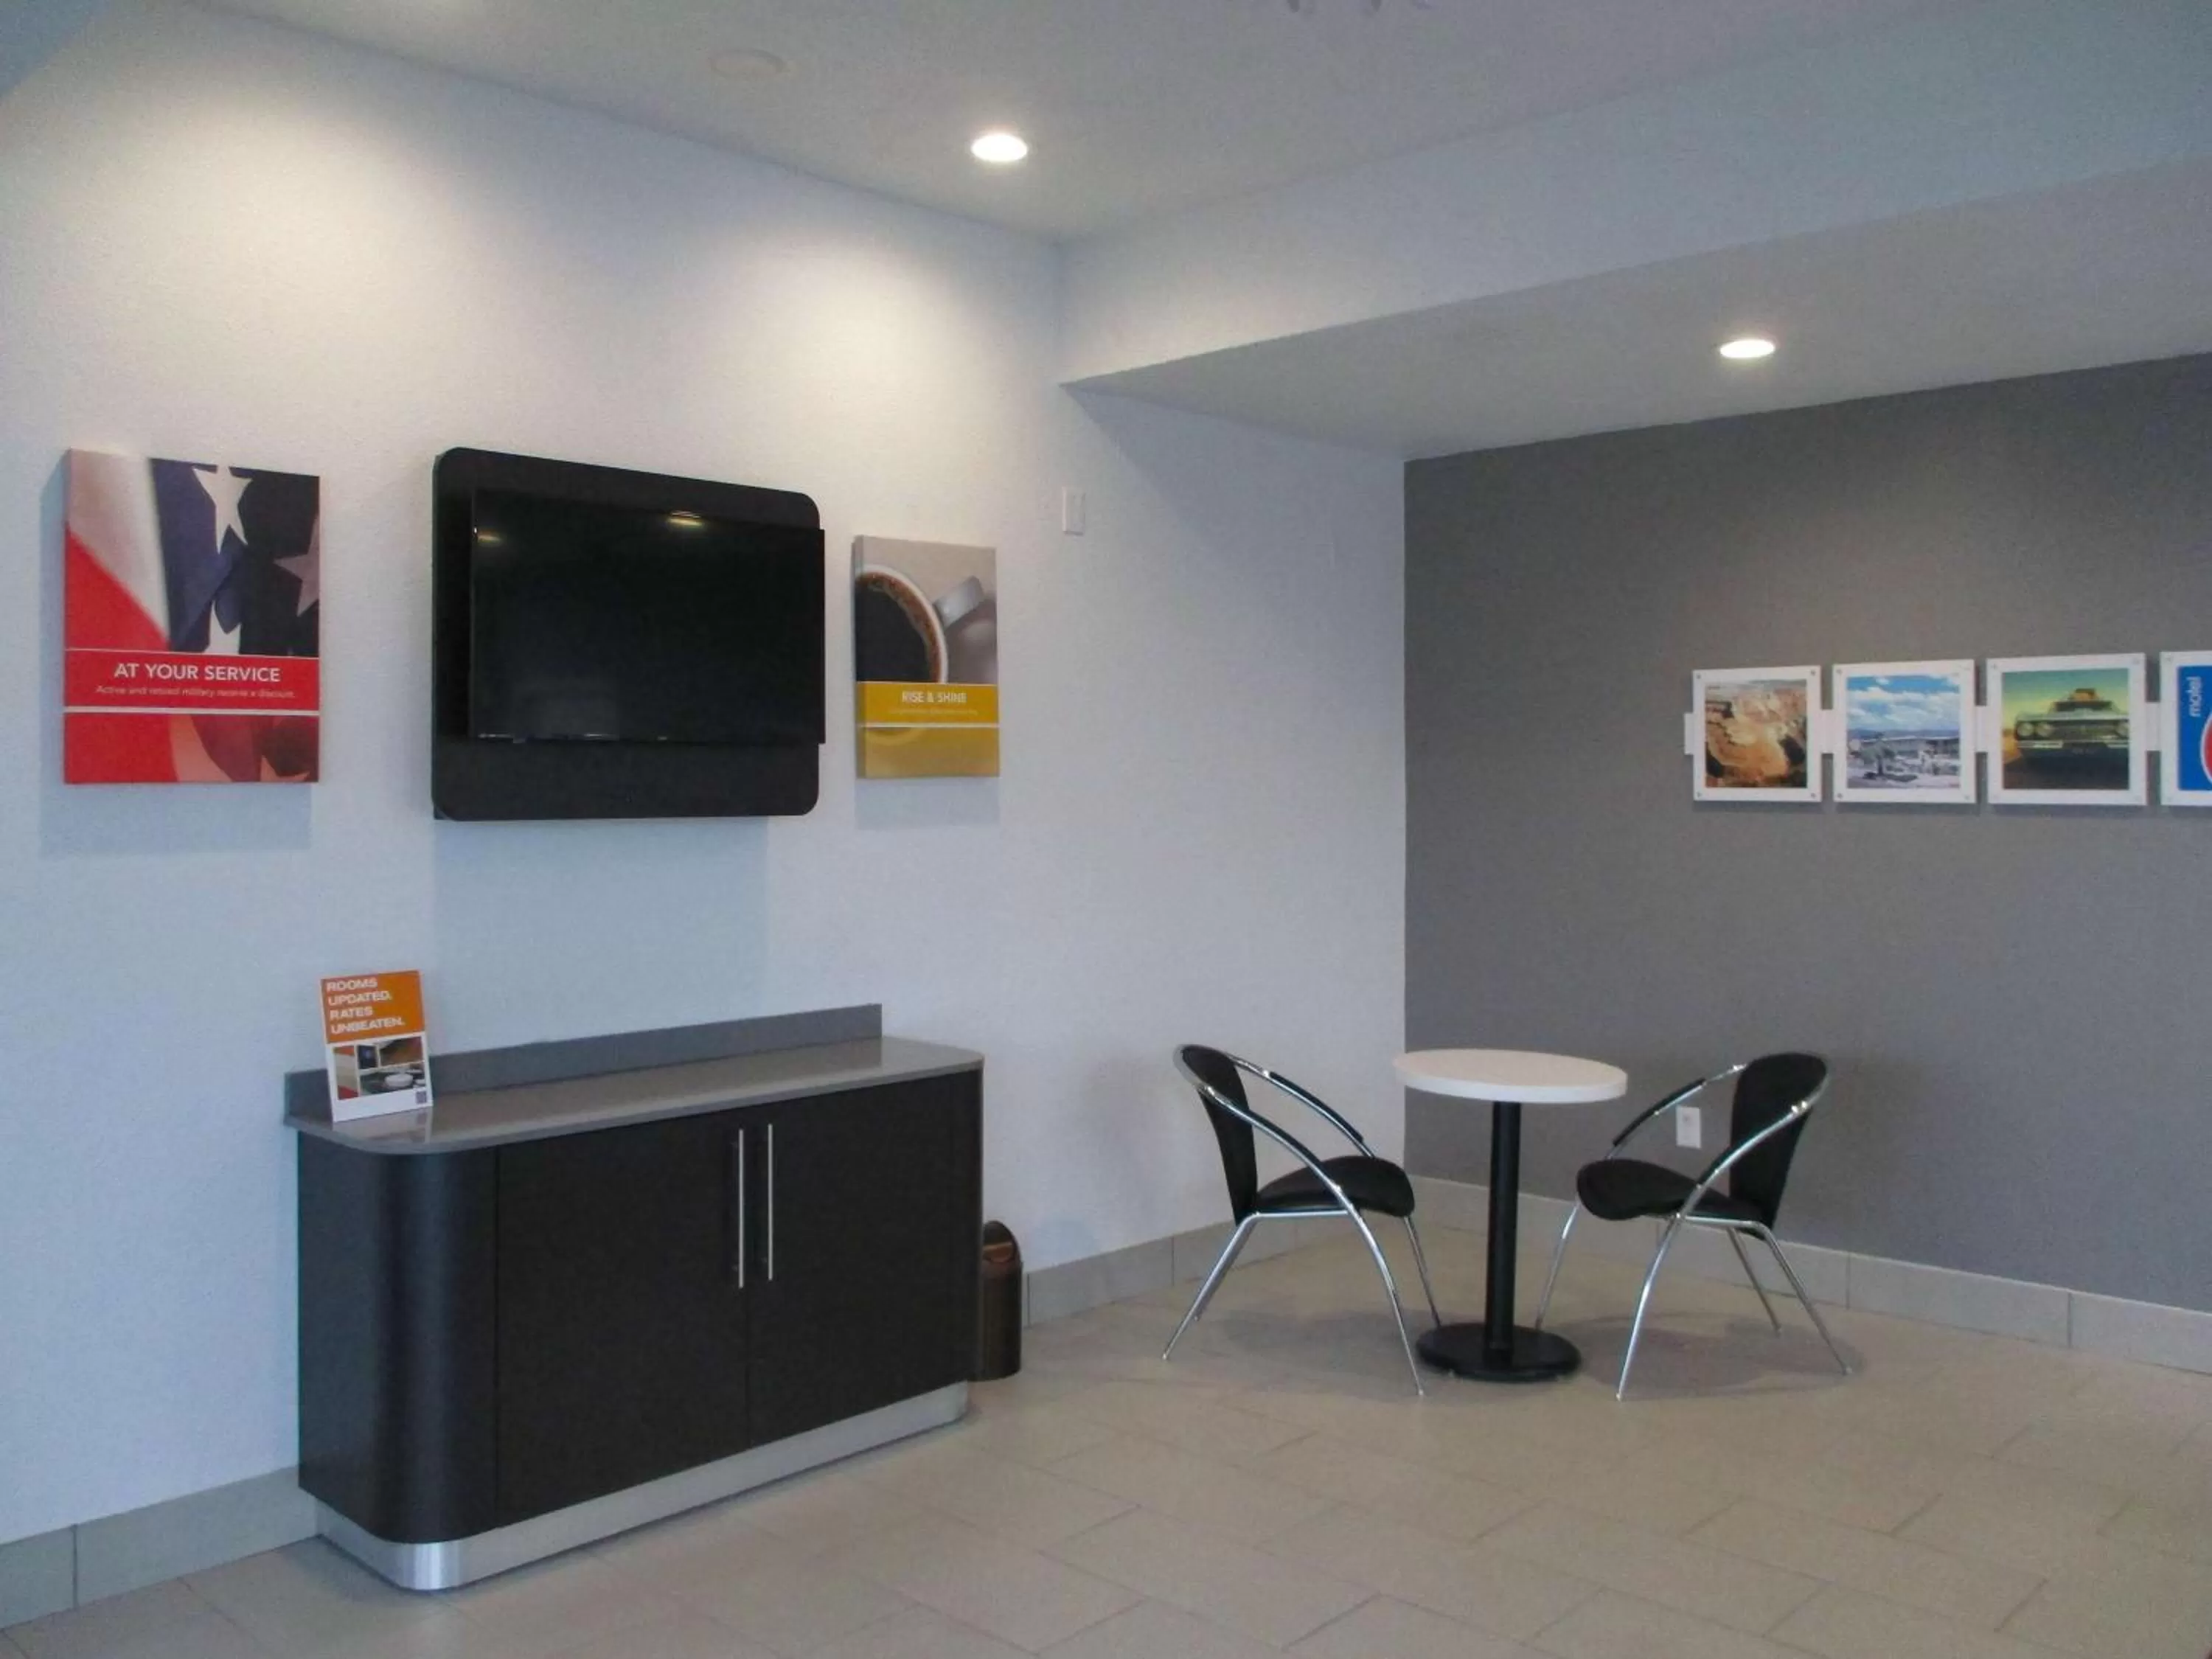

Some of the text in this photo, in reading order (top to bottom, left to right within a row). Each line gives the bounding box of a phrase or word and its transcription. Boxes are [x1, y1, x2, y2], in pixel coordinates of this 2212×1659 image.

[114, 663, 281, 682] AT YOUR SERVICE
[96, 685, 125, 695] Active
[129, 687, 147, 695] and
[182, 688, 214, 698] military
[902, 690, 925, 703] RISE
[937, 692, 967, 703] SHINE
[2185, 675, 2202, 717] motel
[327, 977, 378, 992] ROOMS
[330, 1006, 373, 1020] RATES
[332, 1017, 406, 1034] UNBEATEN.
